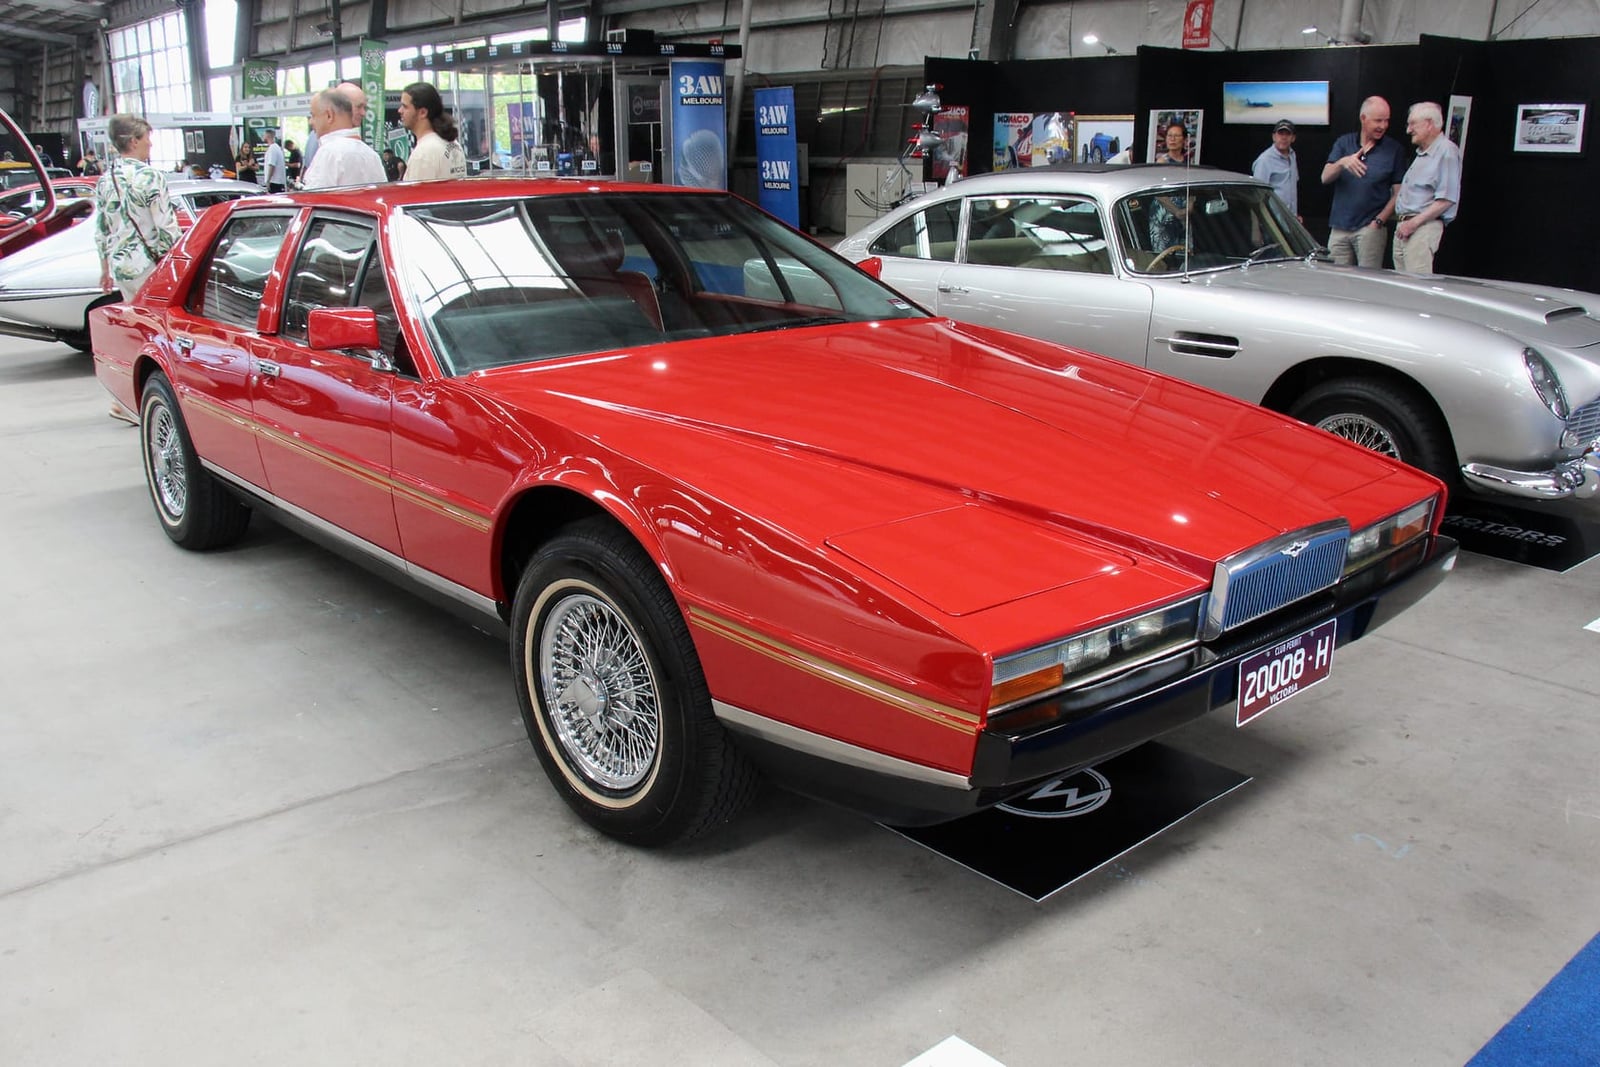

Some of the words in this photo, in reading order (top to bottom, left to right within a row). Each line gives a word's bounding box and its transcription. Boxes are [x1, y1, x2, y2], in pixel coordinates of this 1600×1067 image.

[679, 75, 723, 95] 3AW
[683, 97, 723, 105] MELBOURN
[759, 105, 788, 126] 3AW
[761, 127, 788, 135] MELBOURNE
[762, 160, 791, 180] 3AW
[764, 182, 791, 190] MELBOURNE
[1269, 682, 1299, 704] VICTORIA
